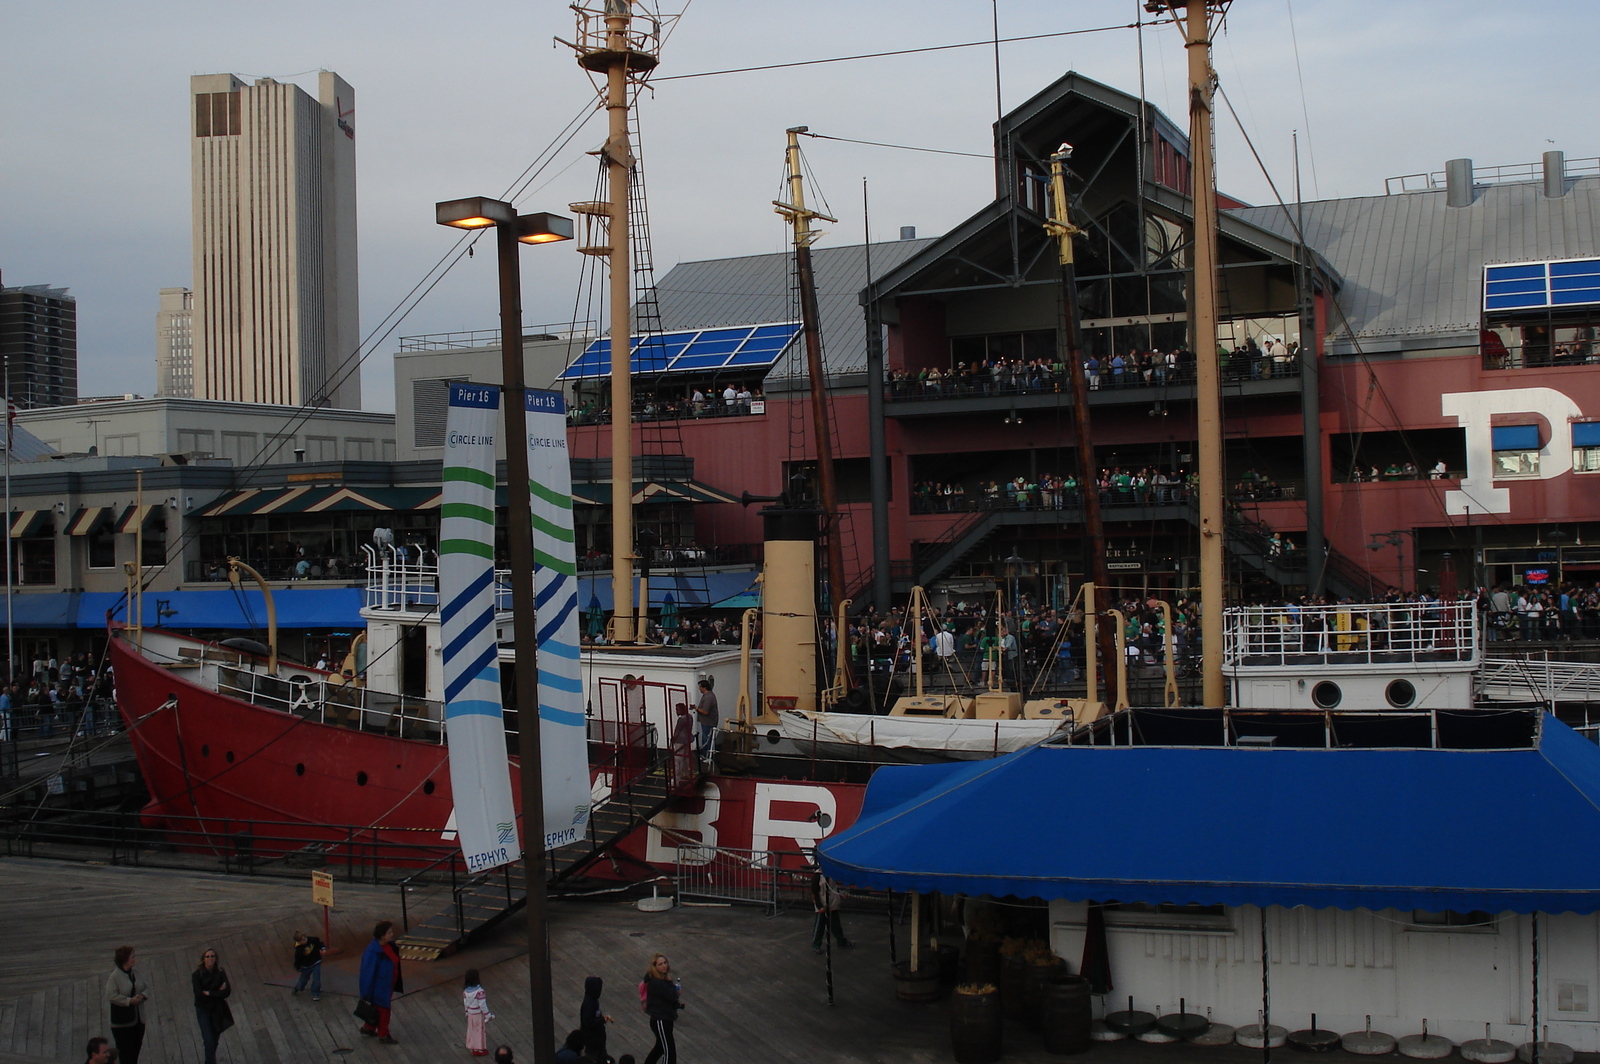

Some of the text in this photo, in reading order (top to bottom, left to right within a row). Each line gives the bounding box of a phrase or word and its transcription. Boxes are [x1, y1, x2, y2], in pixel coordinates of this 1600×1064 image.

[458, 388, 490, 403] Pier 16
[527, 394, 556, 408] Pier 16
[450, 434, 493, 446] CIRCLE LINE
[529, 437, 566, 449] CIRCLE LINE
[1106, 549, 1137, 558] ER 17
[468, 847, 508, 869] ZEPHYR
